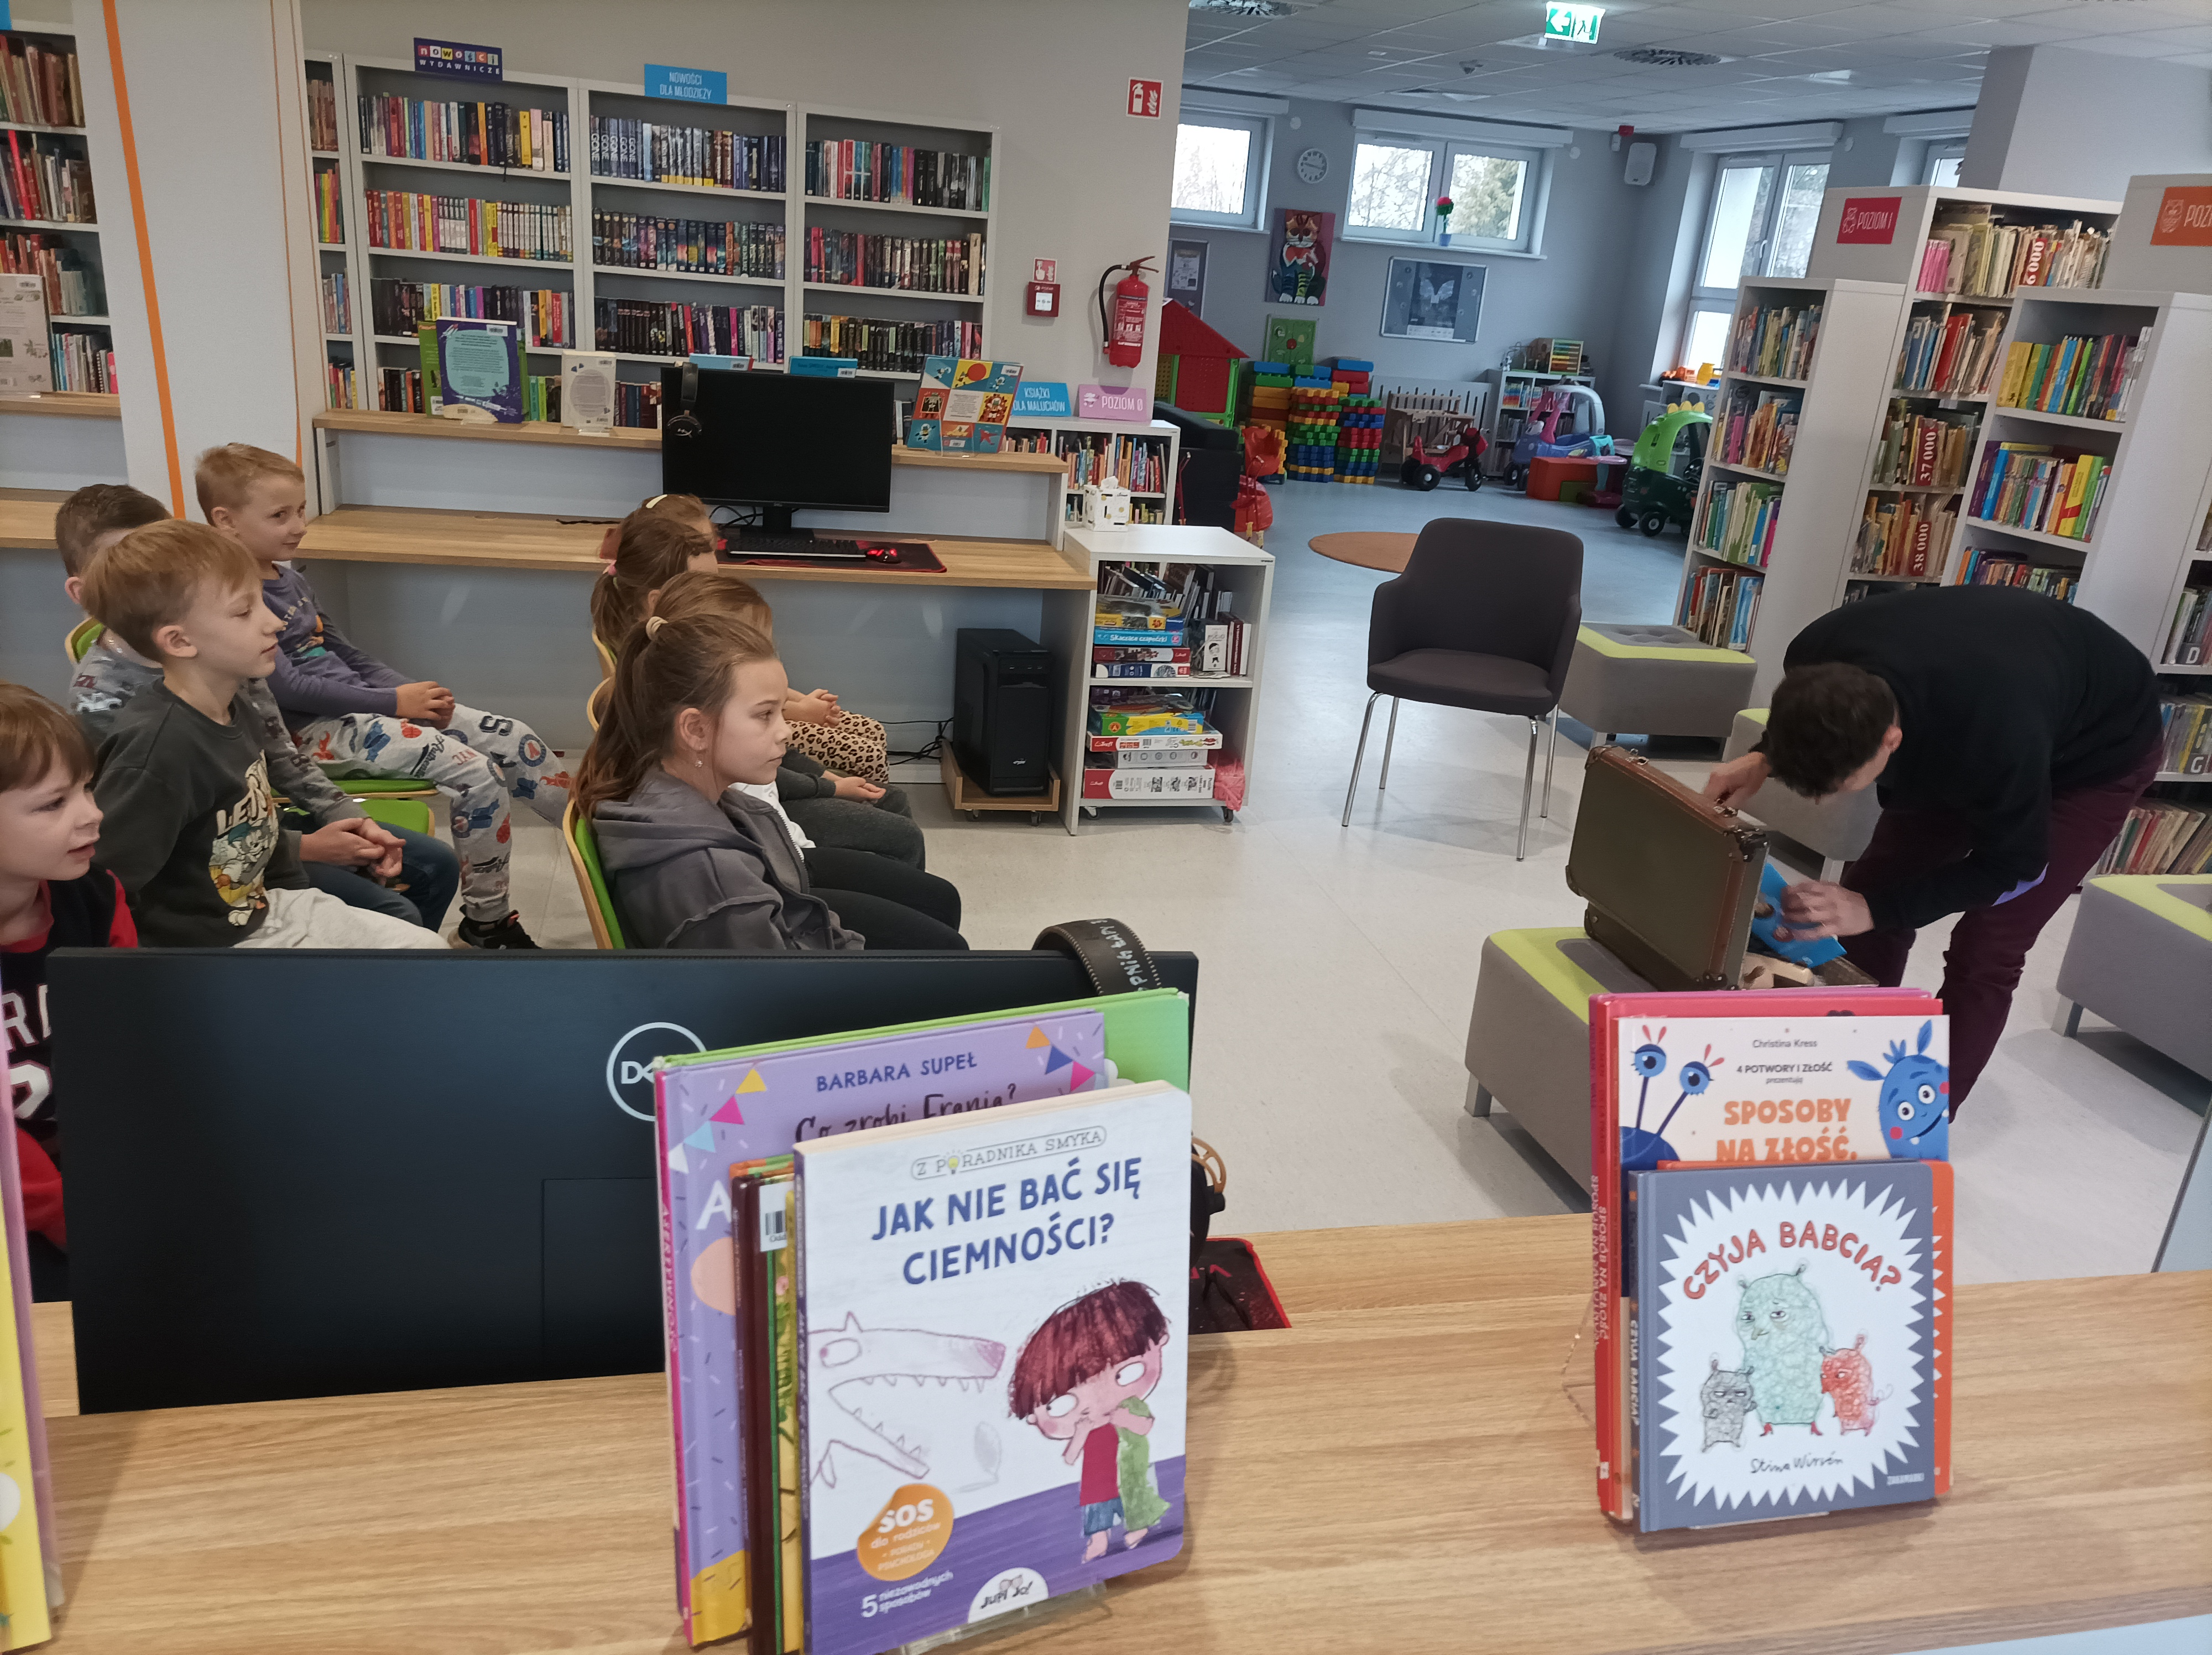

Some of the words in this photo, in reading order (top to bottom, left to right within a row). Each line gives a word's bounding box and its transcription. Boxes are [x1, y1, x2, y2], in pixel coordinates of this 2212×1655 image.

[420, 60, 499, 74] WYDAWNICZE
[669, 72, 702, 85] NOWOŚCI
[660, 84, 673, 96] DLA
[591, 133, 600, 162] GONE
[610, 136, 618, 162] GONE
[620, 137, 628, 162] GONE
[1856, 211, 1888, 230] POZIOM
[1024, 387, 1050, 399] KSIĄŻKI
[1102, 395, 1134, 410] POZIOM
[1013, 400, 1026, 412] DLA
[1027, 400, 1065, 412] MALUCHÓW
[1923, 432, 1936, 460] 000
[1917, 524, 1929, 550] 000
[2190, 756, 2204, 773] G
[816, 1063, 911, 1092] BARBARA
[920, 1052, 978, 1075] SUPEŁ
[1745, 1064, 1795, 1073] POTWORY
[1802, 1061, 1833, 1073] ZŁOŚĆ
[1724, 1098, 1851, 1125] SPOSOBY
[795, 1116, 832, 1143] Co
[916, 1162, 927, 1176] Z
[1045, 1130, 1103, 1152] SMYKA
[1717, 1138, 1756, 1162] NA
[1766, 1126, 1858, 1162] ZŁOŚĆ.
[872, 1197, 935, 1241] JAK
[948, 1183, 1006, 1225] NIE
[1020, 1157, 1083, 1210] BAĆ
[1095, 1157, 1142, 1199] SIĘ
[903, 1211, 1115, 1284] CIEMNOŚCI?
[1683, 1229, 1766, 1299] CZYJA
[1779, 1220, 1902, 1292] BABCIA?
[1599, 1267, 1608, 1288] NA
[1750, 1458, 1791, 1474] Stina
[878, 1498, 934, 1533] SOS
[871, 1536, 889, 1549] dla
[861, 1594, 878, 1618] 5
